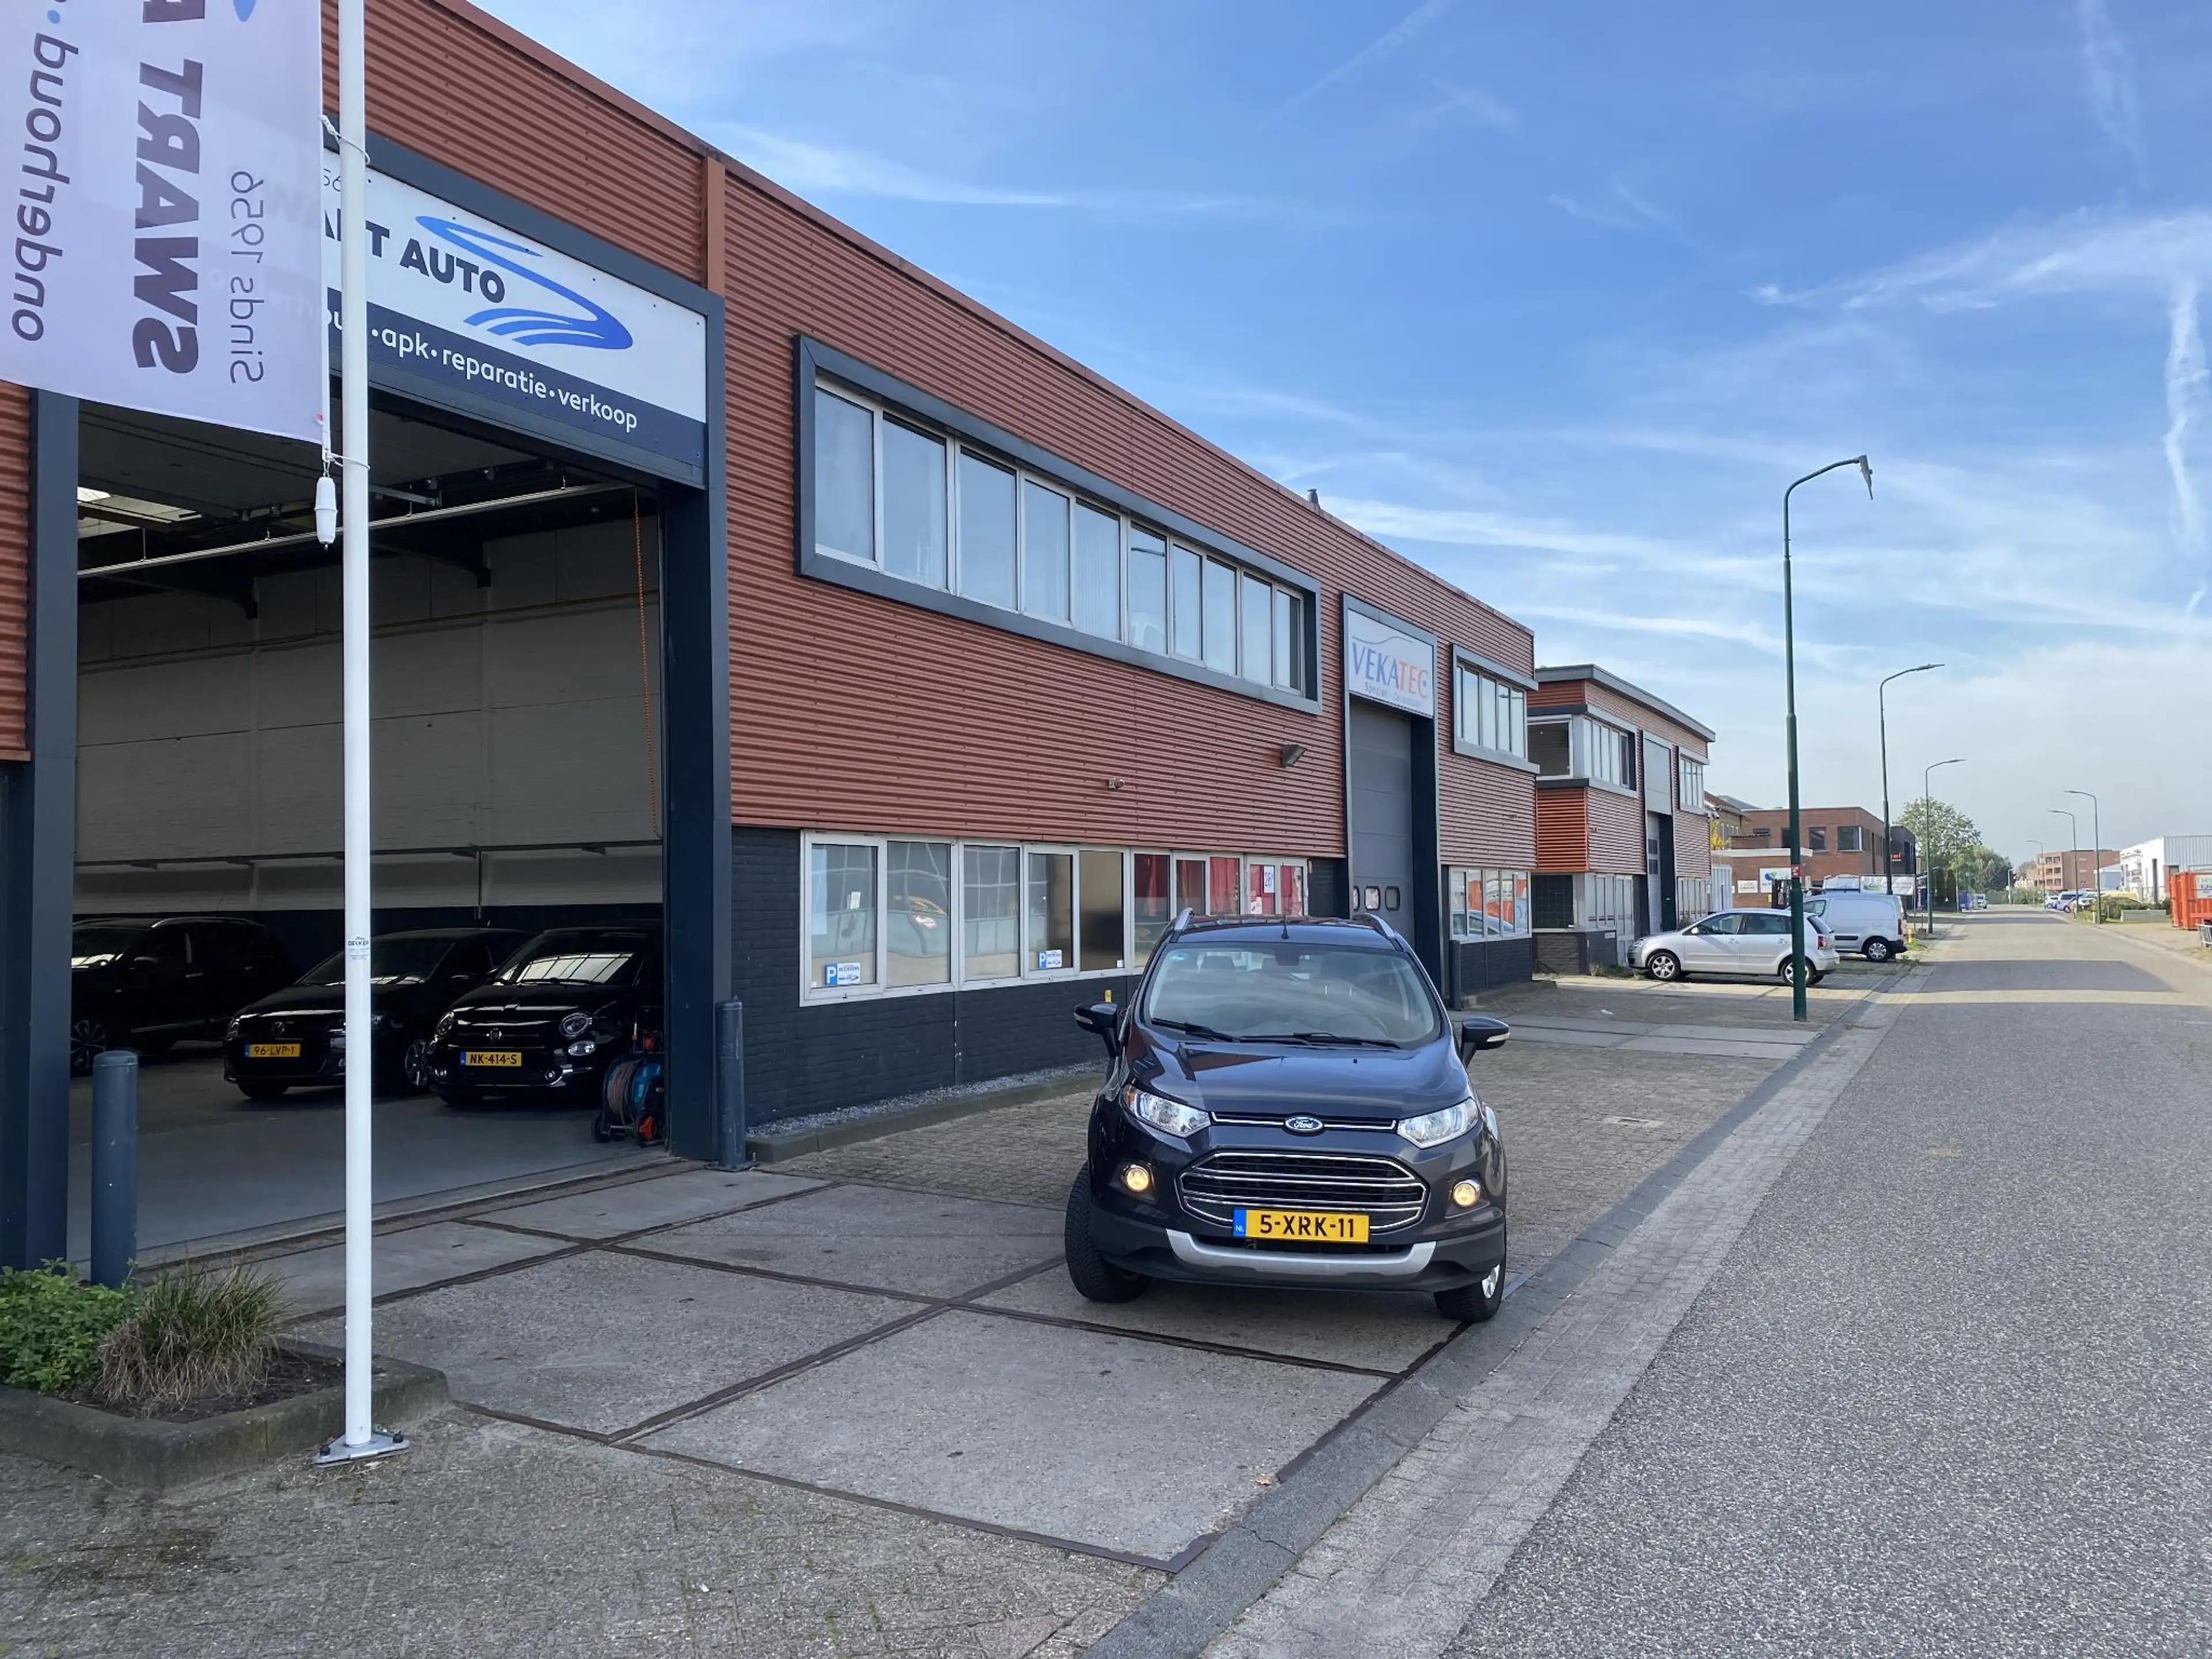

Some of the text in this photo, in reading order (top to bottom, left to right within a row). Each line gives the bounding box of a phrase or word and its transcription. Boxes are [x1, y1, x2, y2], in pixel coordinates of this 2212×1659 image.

[399, 238, 505, 303] AUTO
[442, 349, 547, 399] reparatie
[557, 388, 637, 433] verkoop
[254, 1046, 295, 1055] 96-LVP-1
[470, 1054, 517, 1065] NK-414-S
[1260, 1214, 1354, 1238] 5-XRK-11
